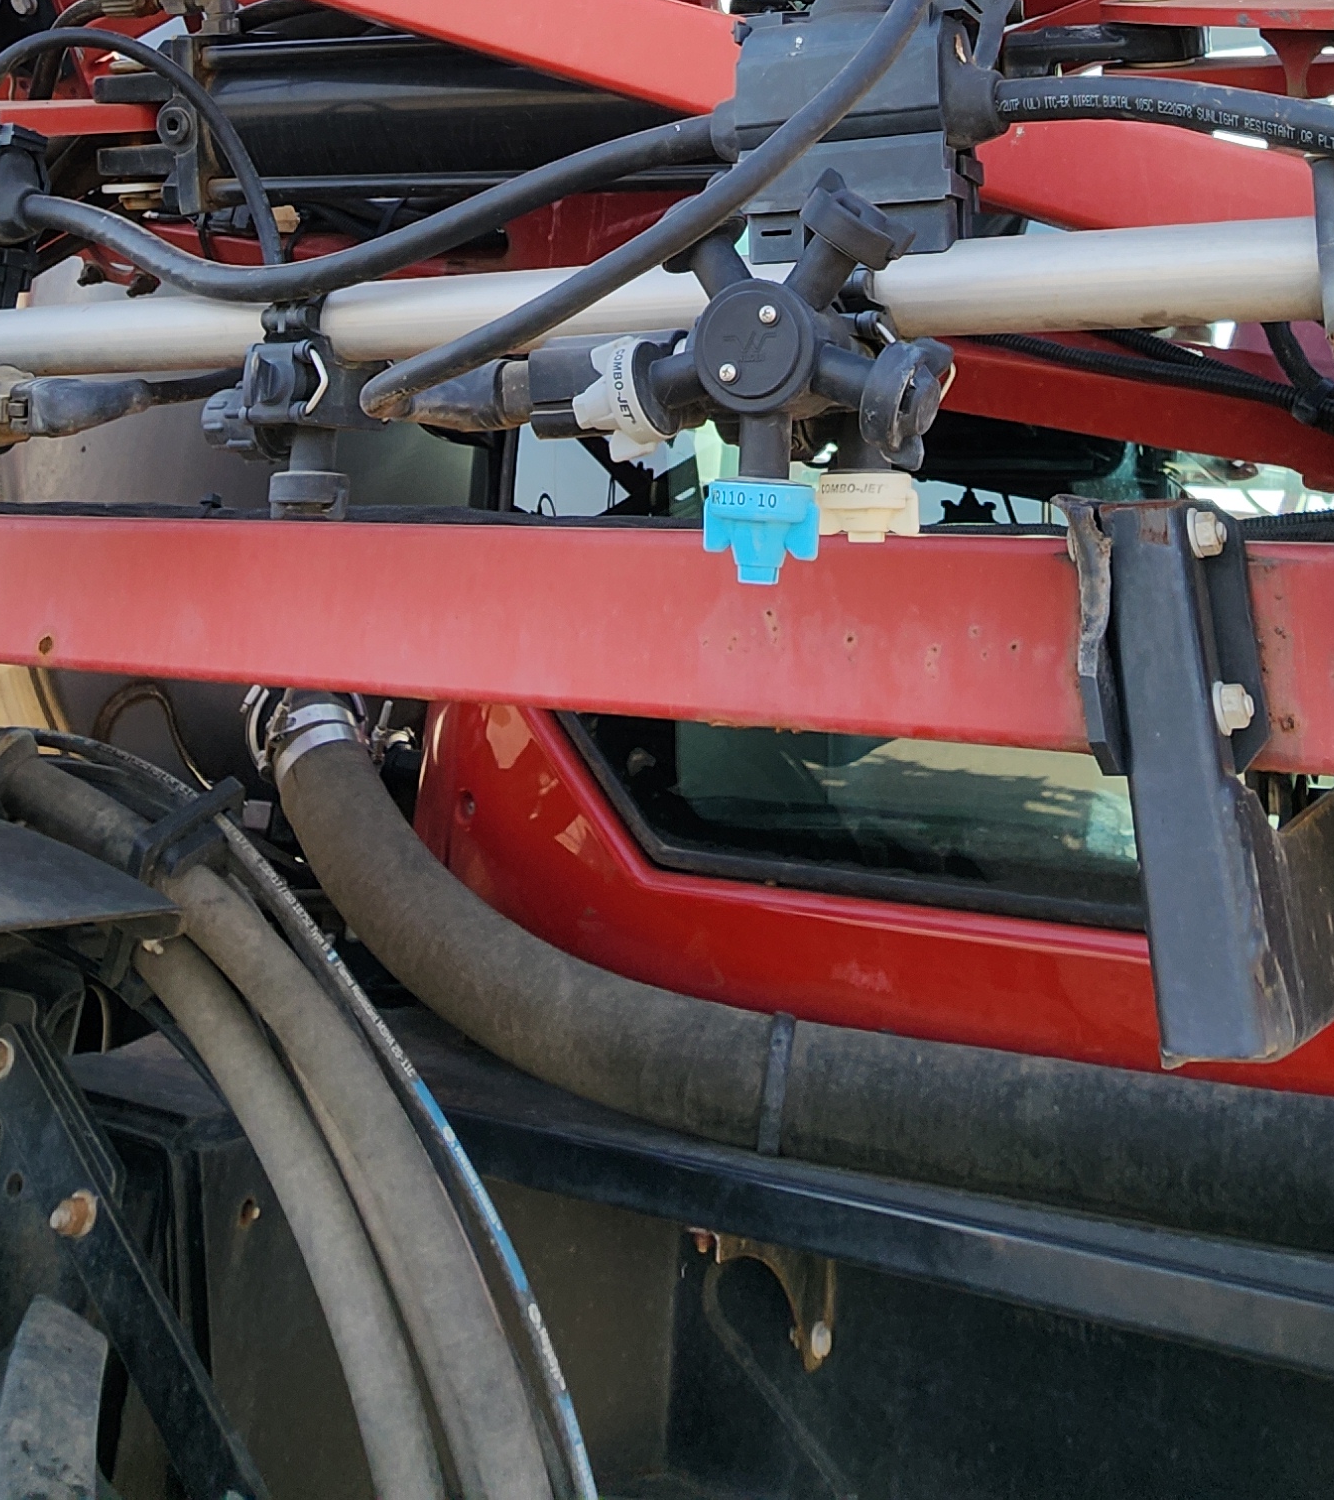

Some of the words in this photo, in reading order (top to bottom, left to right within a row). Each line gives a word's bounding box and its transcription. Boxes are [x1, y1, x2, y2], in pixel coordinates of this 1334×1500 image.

[1073, 94, 1100, 108] DIRECT
[1102, 94, 1131, 110] BURIAL
[1196, 107, 1240, 127] SUNLIGHT
[1244, 115, 1295, 141] RESISTANT
